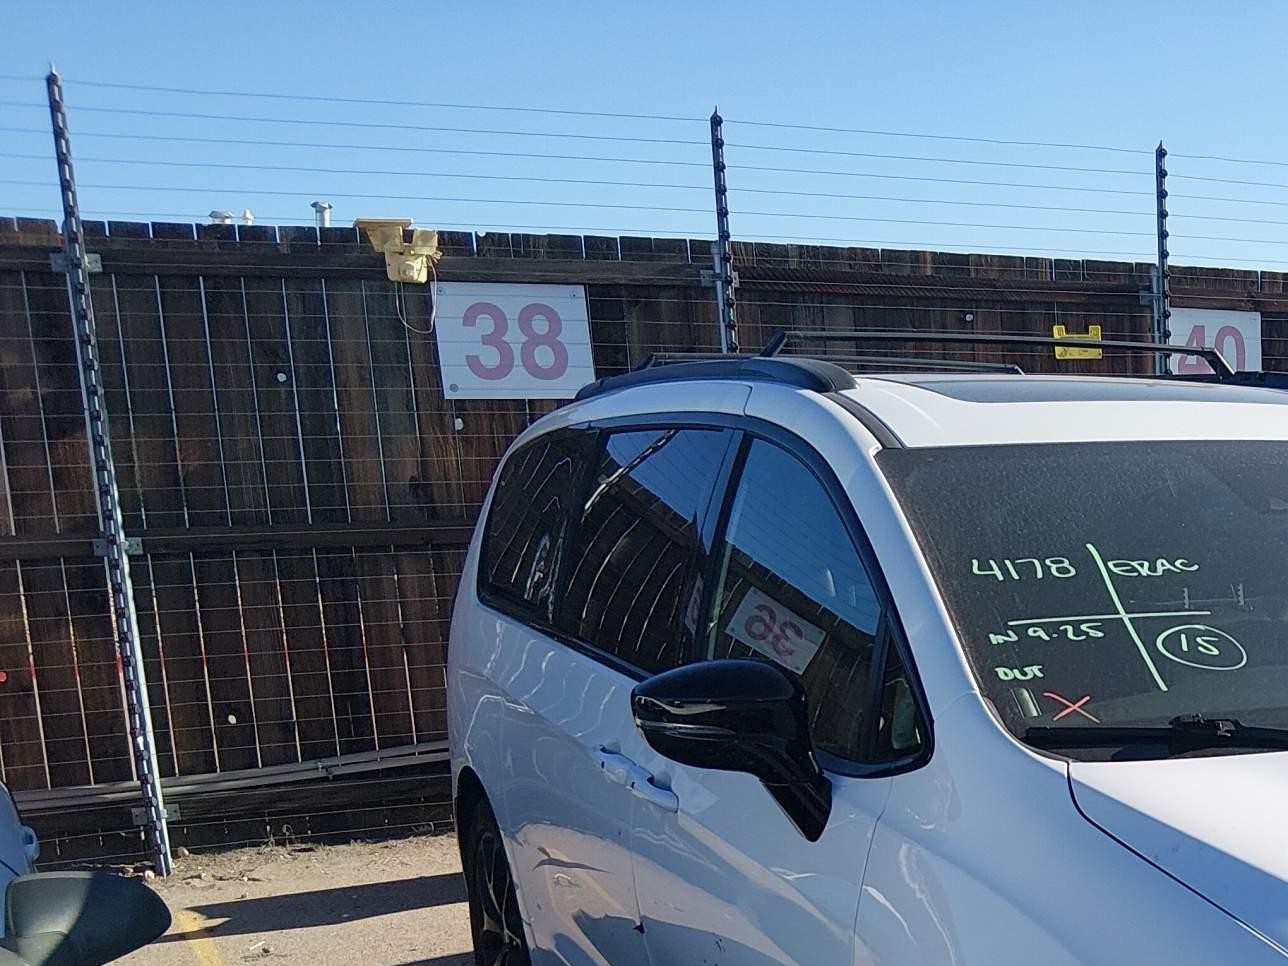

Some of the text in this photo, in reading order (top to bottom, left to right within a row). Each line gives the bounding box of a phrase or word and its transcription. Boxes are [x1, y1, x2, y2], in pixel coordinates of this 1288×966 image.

[463, 302, 569, 380] 38
[1178, 325, 1246, 374] 40
[972, 557, 1076, 581] 4178
[1106, 558, 1200, 577] ERAC
[1180, 634, 1220, 656] 15
[994, 665, 1045, 681] OUT
